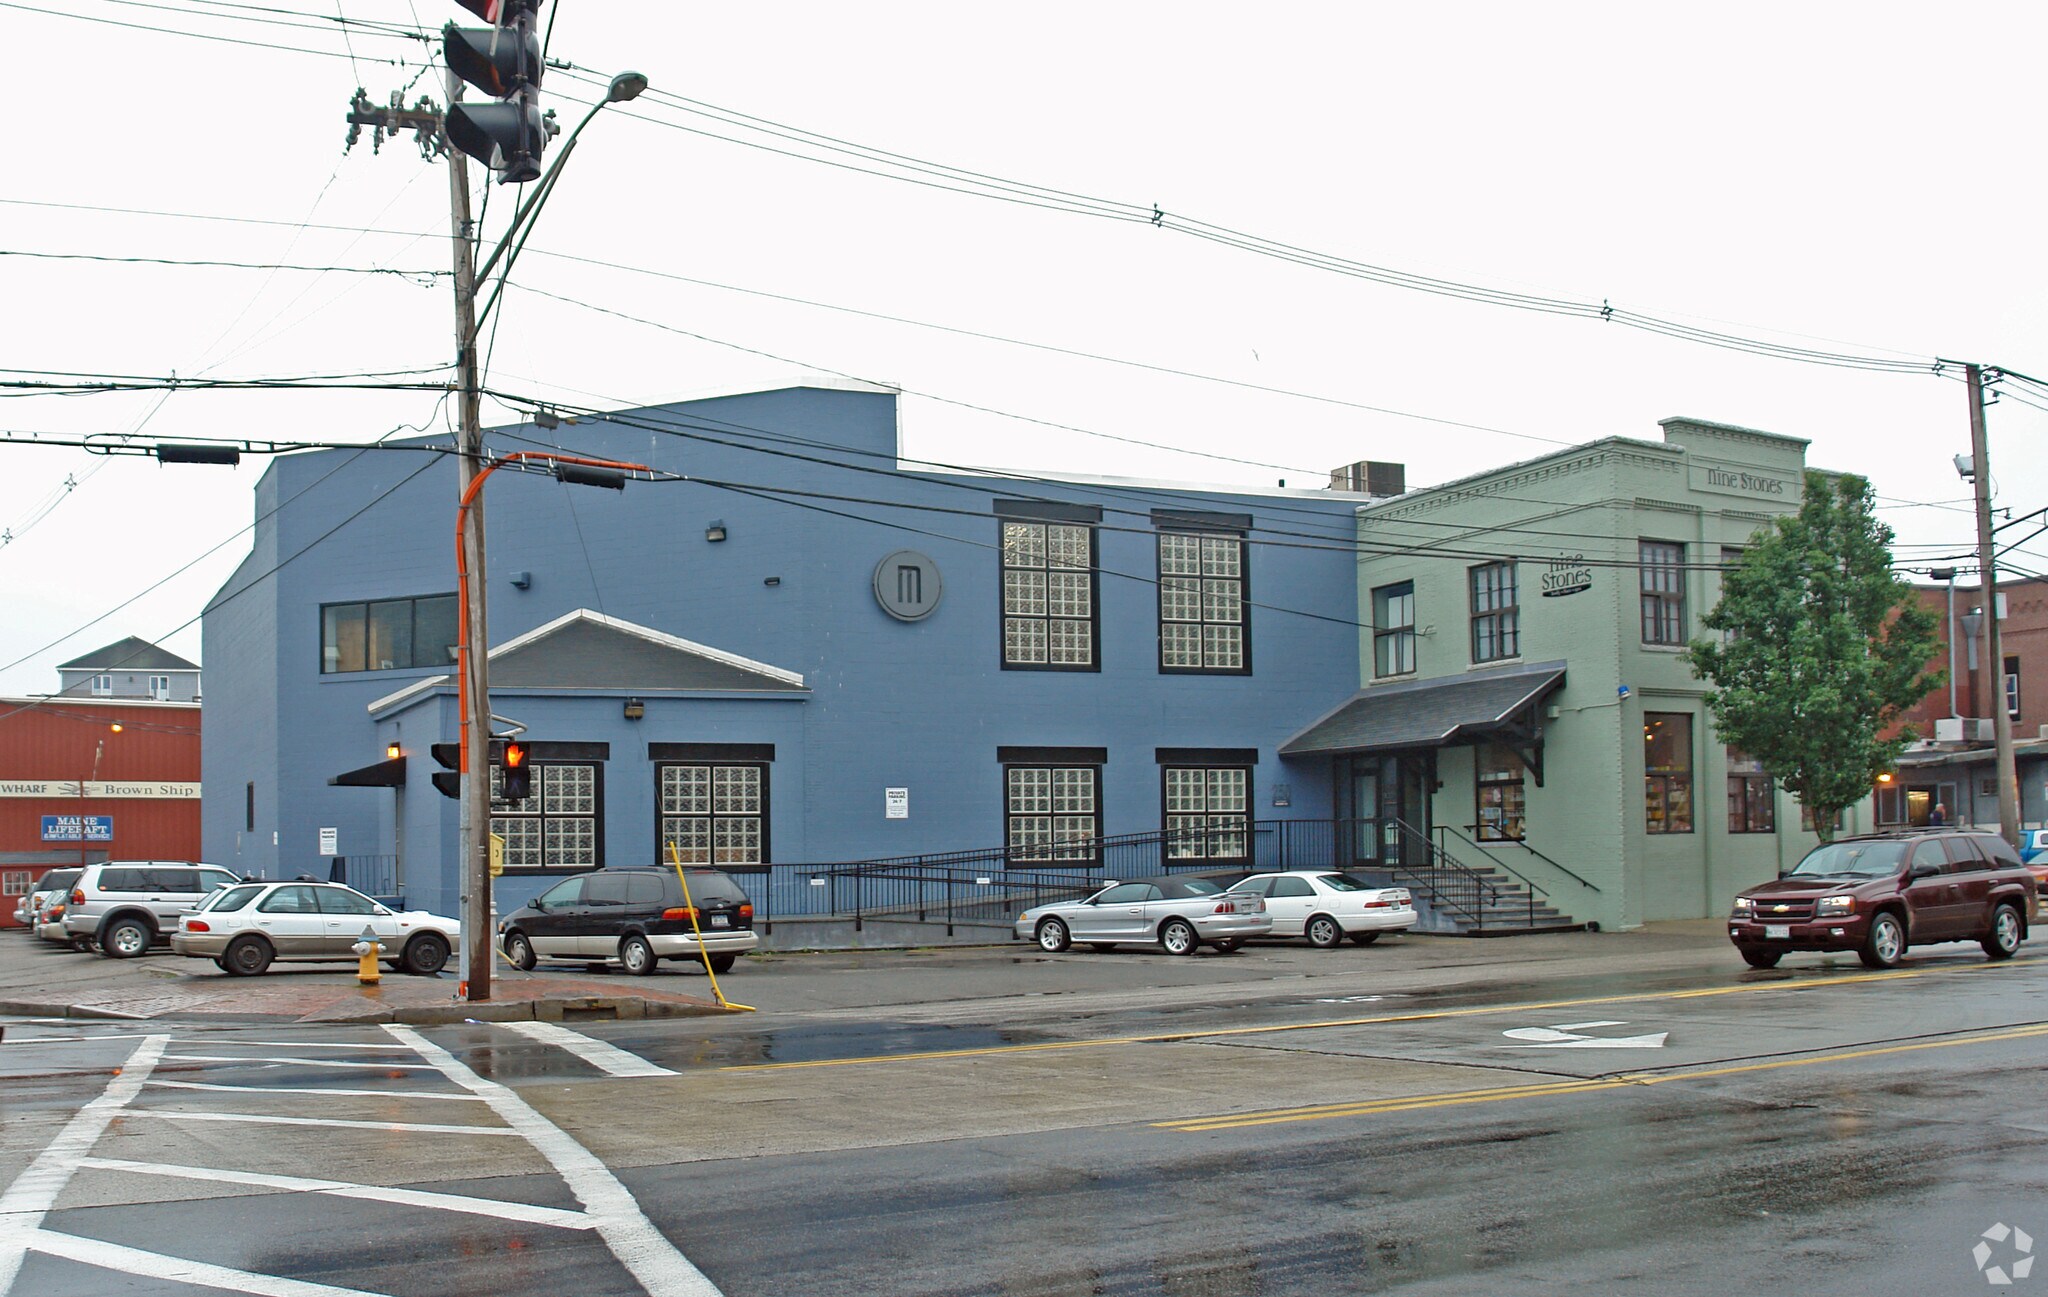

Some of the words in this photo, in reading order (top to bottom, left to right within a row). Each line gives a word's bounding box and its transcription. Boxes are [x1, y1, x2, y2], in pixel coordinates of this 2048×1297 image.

[1, 784, 47, 793] WHARF
[105, 784, 153, 795] Brown
[160, 784, 194, 796] Ship
[57, 816, 97, 825] MAINE
